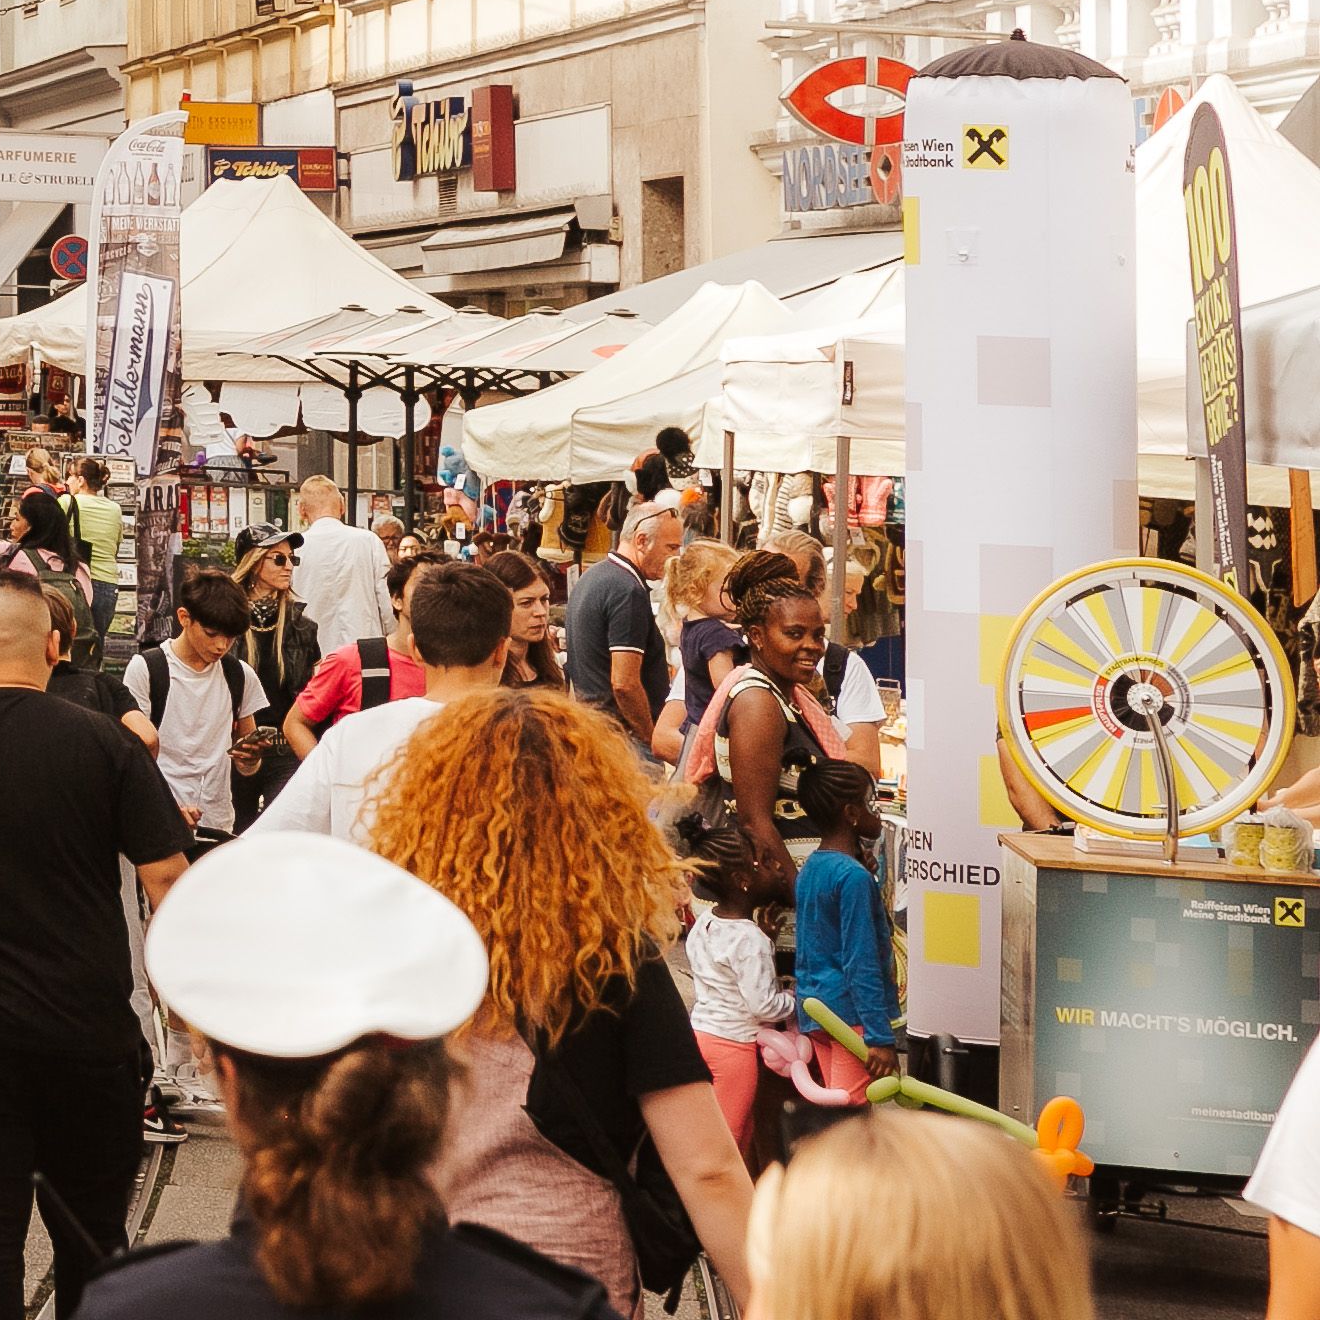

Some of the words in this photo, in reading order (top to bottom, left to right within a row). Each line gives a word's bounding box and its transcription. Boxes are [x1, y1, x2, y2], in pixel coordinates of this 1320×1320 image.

[922, 138, 954, 152] Wien
[231, 160, 295, 177] Tchibo
[782, 143, 874, 213] NORDSEE
[1190, 900, 1241, 914] Raiffeisen
[1243, 902, 1271, 915] Wien
[1182, 909, 1215, 921] Meine
[1217, 910, 1271, 925] Stadtbank
[1055, 1006, 1095, 1026] WIR
[1100, 1010, 1192, 1034] MACHT'S
[1196, 1015, 1299, 1043] MÖGLICH.
[1191, 1106, 1275, 1122] meinestadtban
